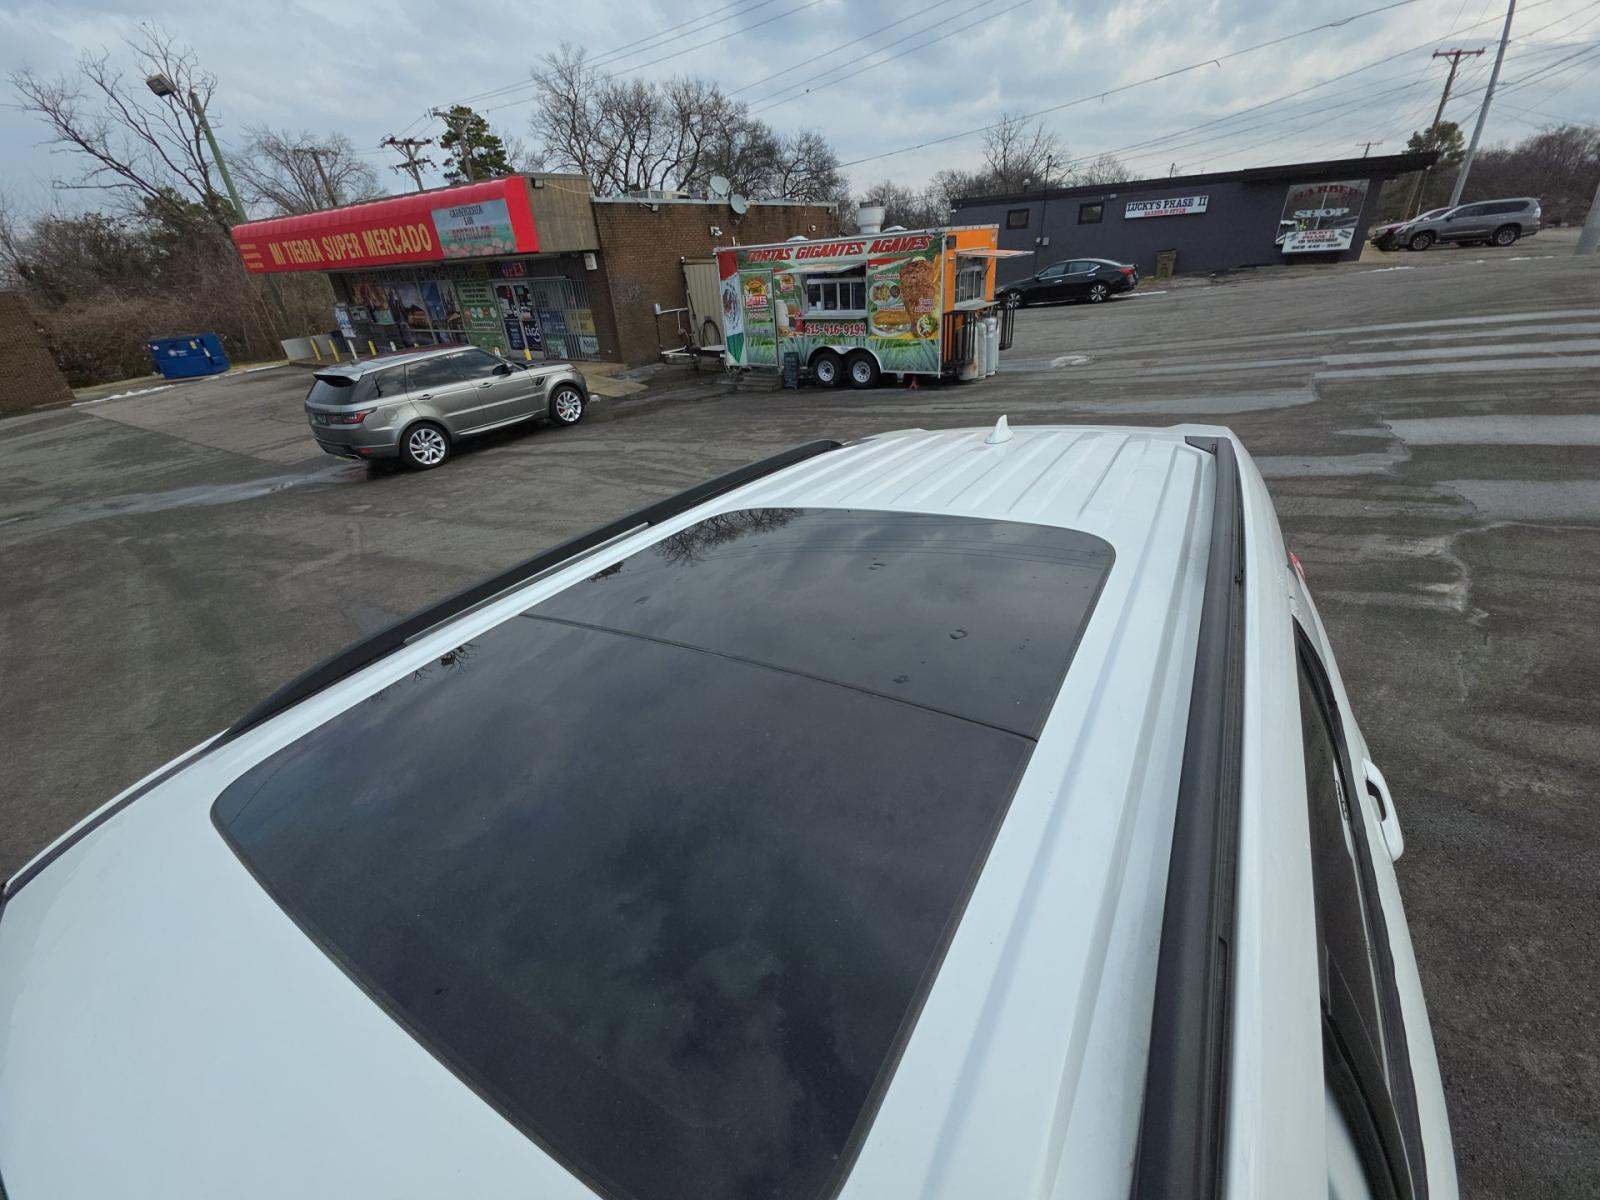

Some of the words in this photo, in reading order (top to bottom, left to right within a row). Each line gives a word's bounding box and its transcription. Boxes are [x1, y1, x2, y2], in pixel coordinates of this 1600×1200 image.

[1127, 200, 1162, 211] LUCKY'S
[1163, 198, 1194, 209] PHASE
[1197, 196, 1208, 206] II
[1293, 208, 1349, 218] SHOP
[268, 242, 286, 265] MI
[283, 238, 324, 264] TIERRA
[322, 232, 365, 261] SUPER
[361, 223, 432, 257] MERCADO
[747, 247, 793, 263] TORTAS
[795, 241, 866, 259] GIGANTES
[867, 235, 933, 254] AGAVES
